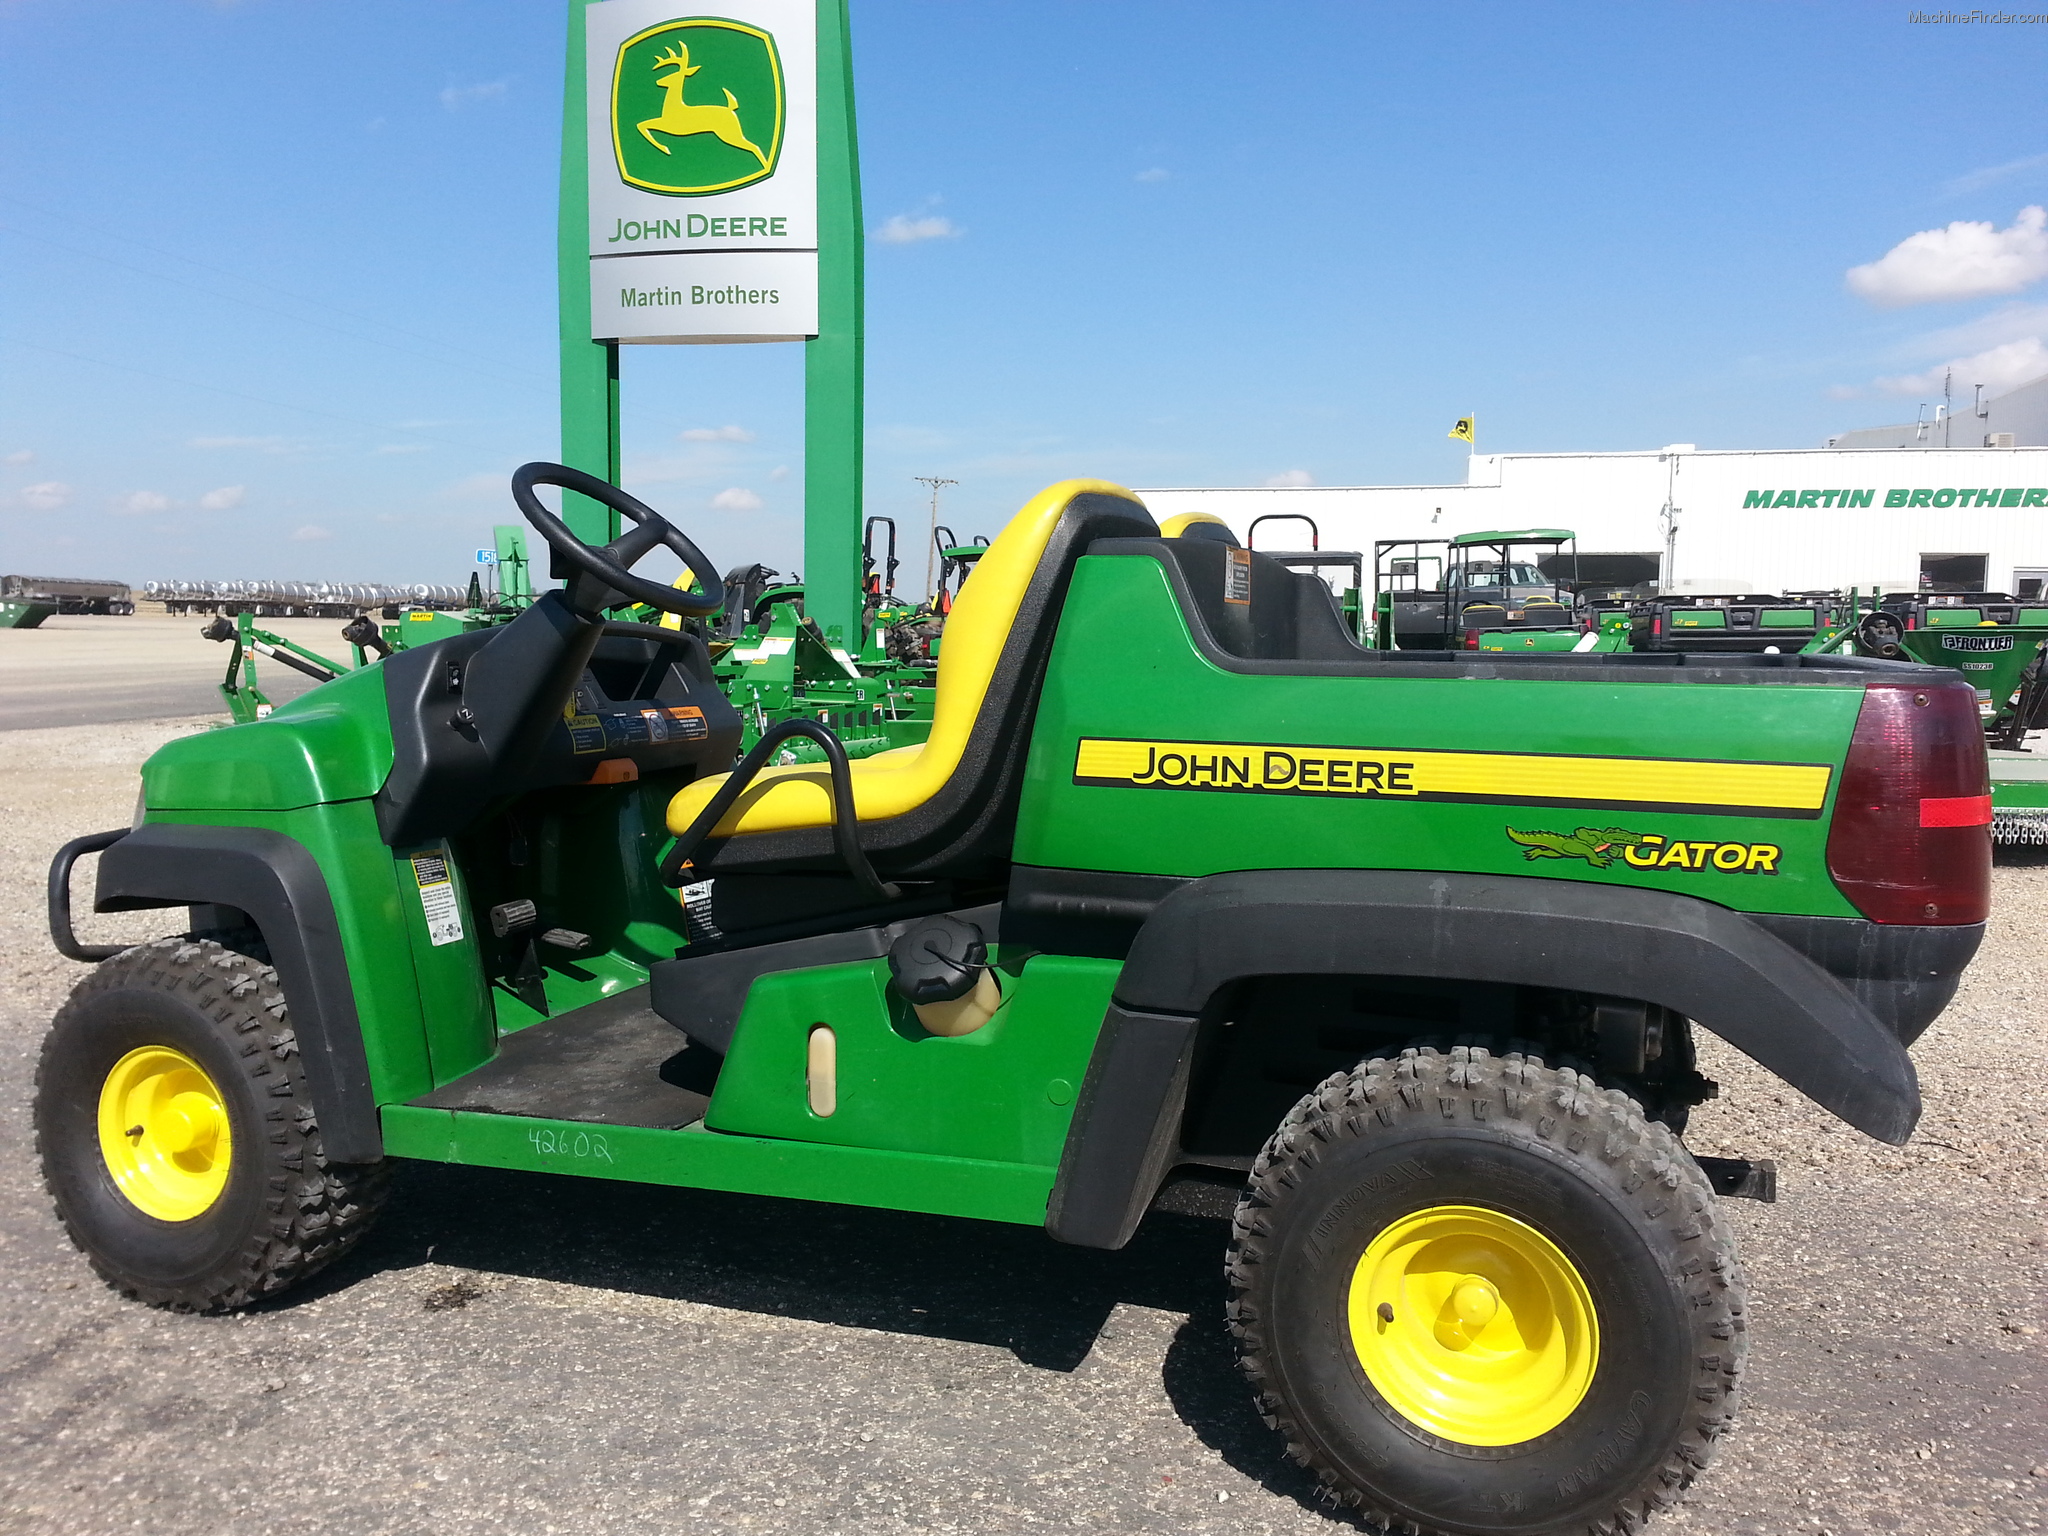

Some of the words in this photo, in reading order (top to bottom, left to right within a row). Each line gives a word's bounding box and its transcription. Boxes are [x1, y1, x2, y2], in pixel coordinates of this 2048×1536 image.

[608, 218, 681, 243] JOHN
[687, 213, 788, 238] DEERE
[620, 285, 682, 308] Martin
[691, 284, 780, 305] Brothers
[1743, 489, 1876, 509] MARTIN
[1883, 487, 2048, 509] BROTHER
[1954, 635, 2014, 652] FRONTIER
[1131, 746, 1250, 783] JOHN
[1262, 750, 1415, 791] DEERE
[1624, 835, 1782, 872] GATOR
[528, 1127, 614, 1165] 42602
